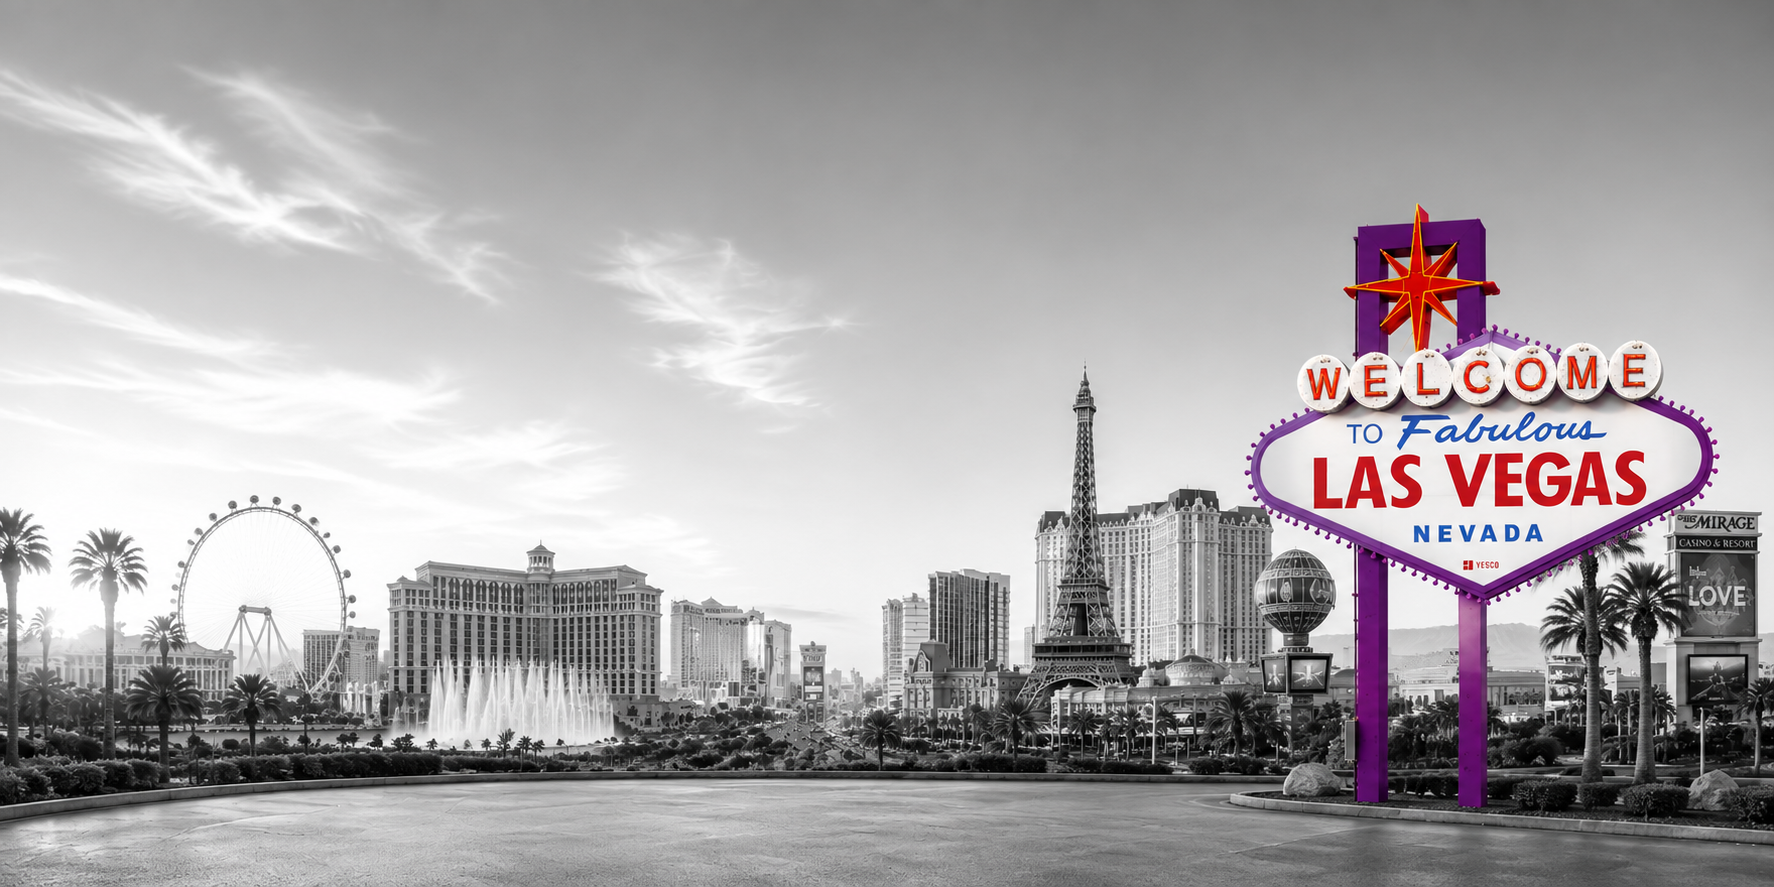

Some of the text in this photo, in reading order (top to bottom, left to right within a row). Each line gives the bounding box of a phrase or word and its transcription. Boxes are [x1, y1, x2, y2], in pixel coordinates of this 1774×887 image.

[1306, 353, 1647, 401] WELCOME
[1346, 411, 1607, 450] TO Fabulous
[1313, 450, 1647, 509] LAS VEGAS
[1413, 523, 1544, 543] NEVADA
[1685, 515, 1756, 532] MIRAGE
[1679, 539, 1712, 548] CASINO
[1723, 539, 1756, 548] RESORT
[1475, 561, 1500, 569] YESCO
[1688, 585, 1746, 606] LOVE
